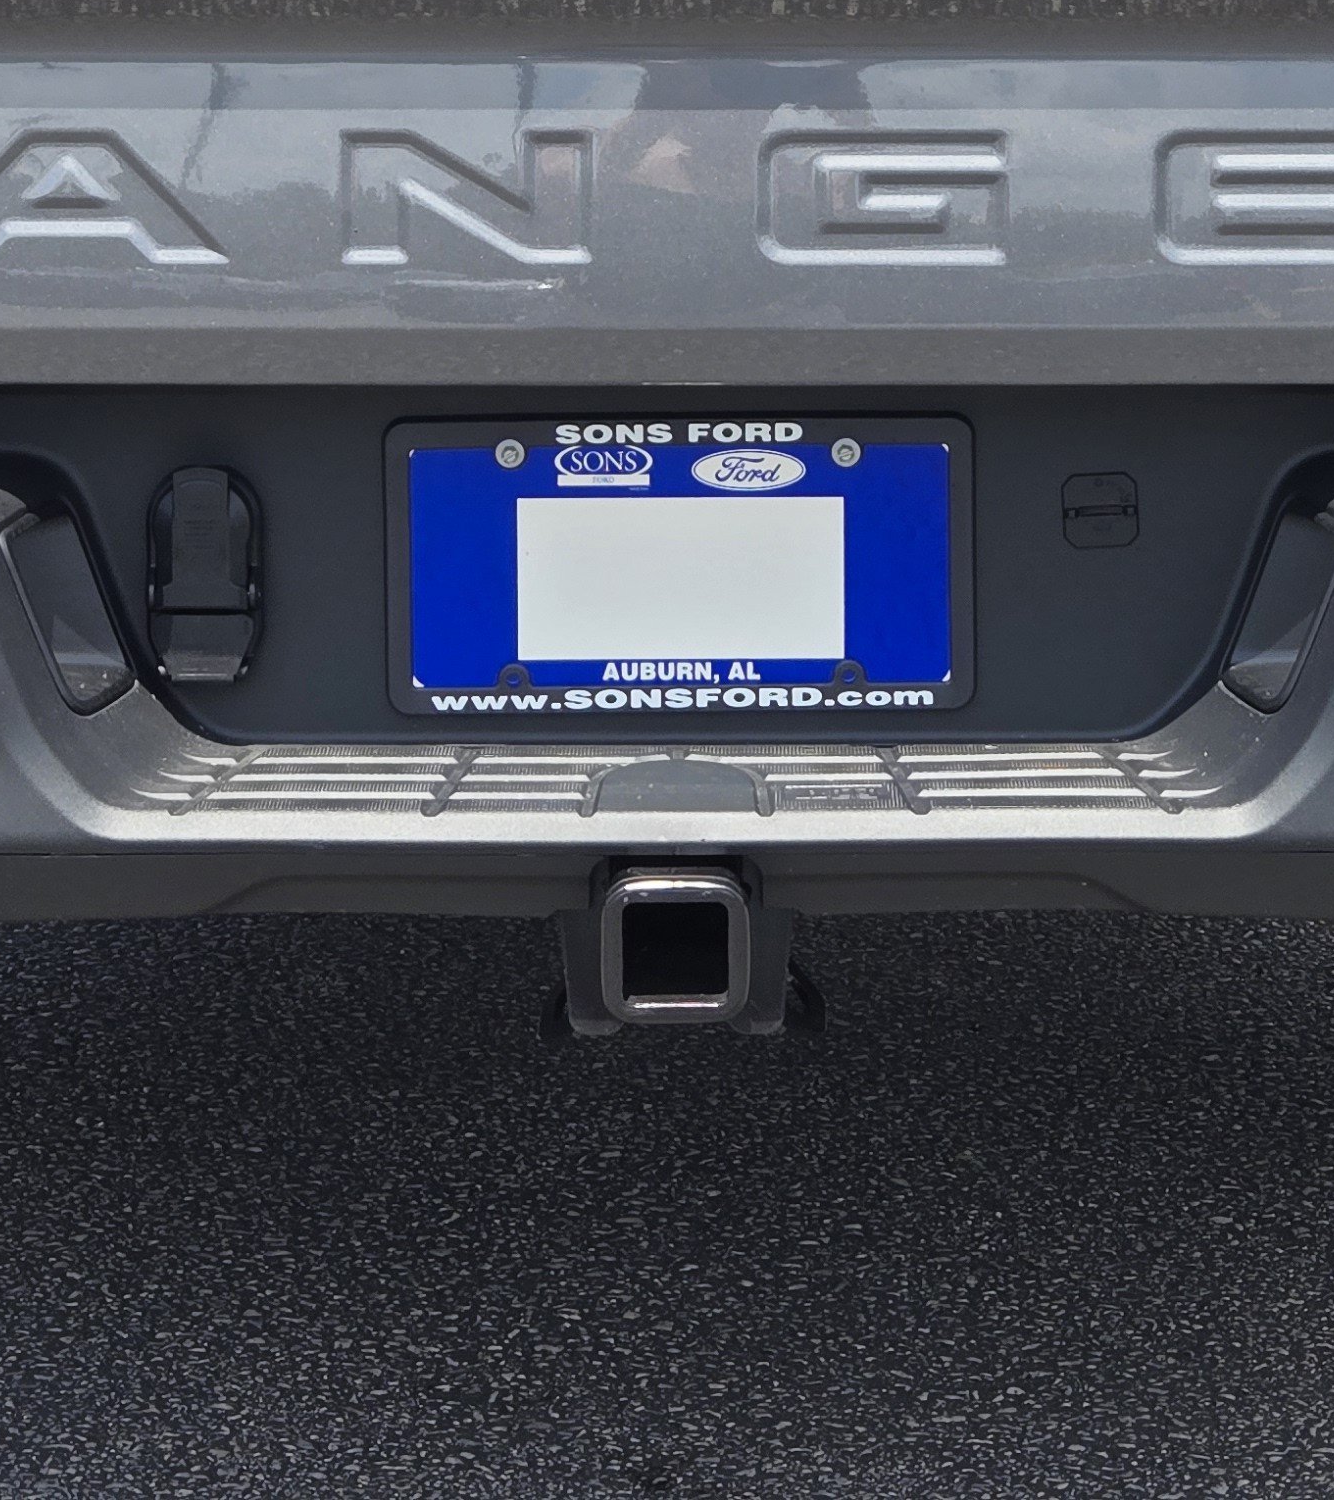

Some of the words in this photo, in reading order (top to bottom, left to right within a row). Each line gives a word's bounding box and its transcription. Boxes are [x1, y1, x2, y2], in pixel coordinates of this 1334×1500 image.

[555, 423, 673, 445] SONS
[688, 422, 804, 443] FORD
[570, 450, 638, 473] SONS
[715, 456, 782, 483] Ford
[602, 662, 720, 683] AUBURN,
[728, 662, 761, 681] AL
[432, 688, 935, 711] www.SONSFORD.com
